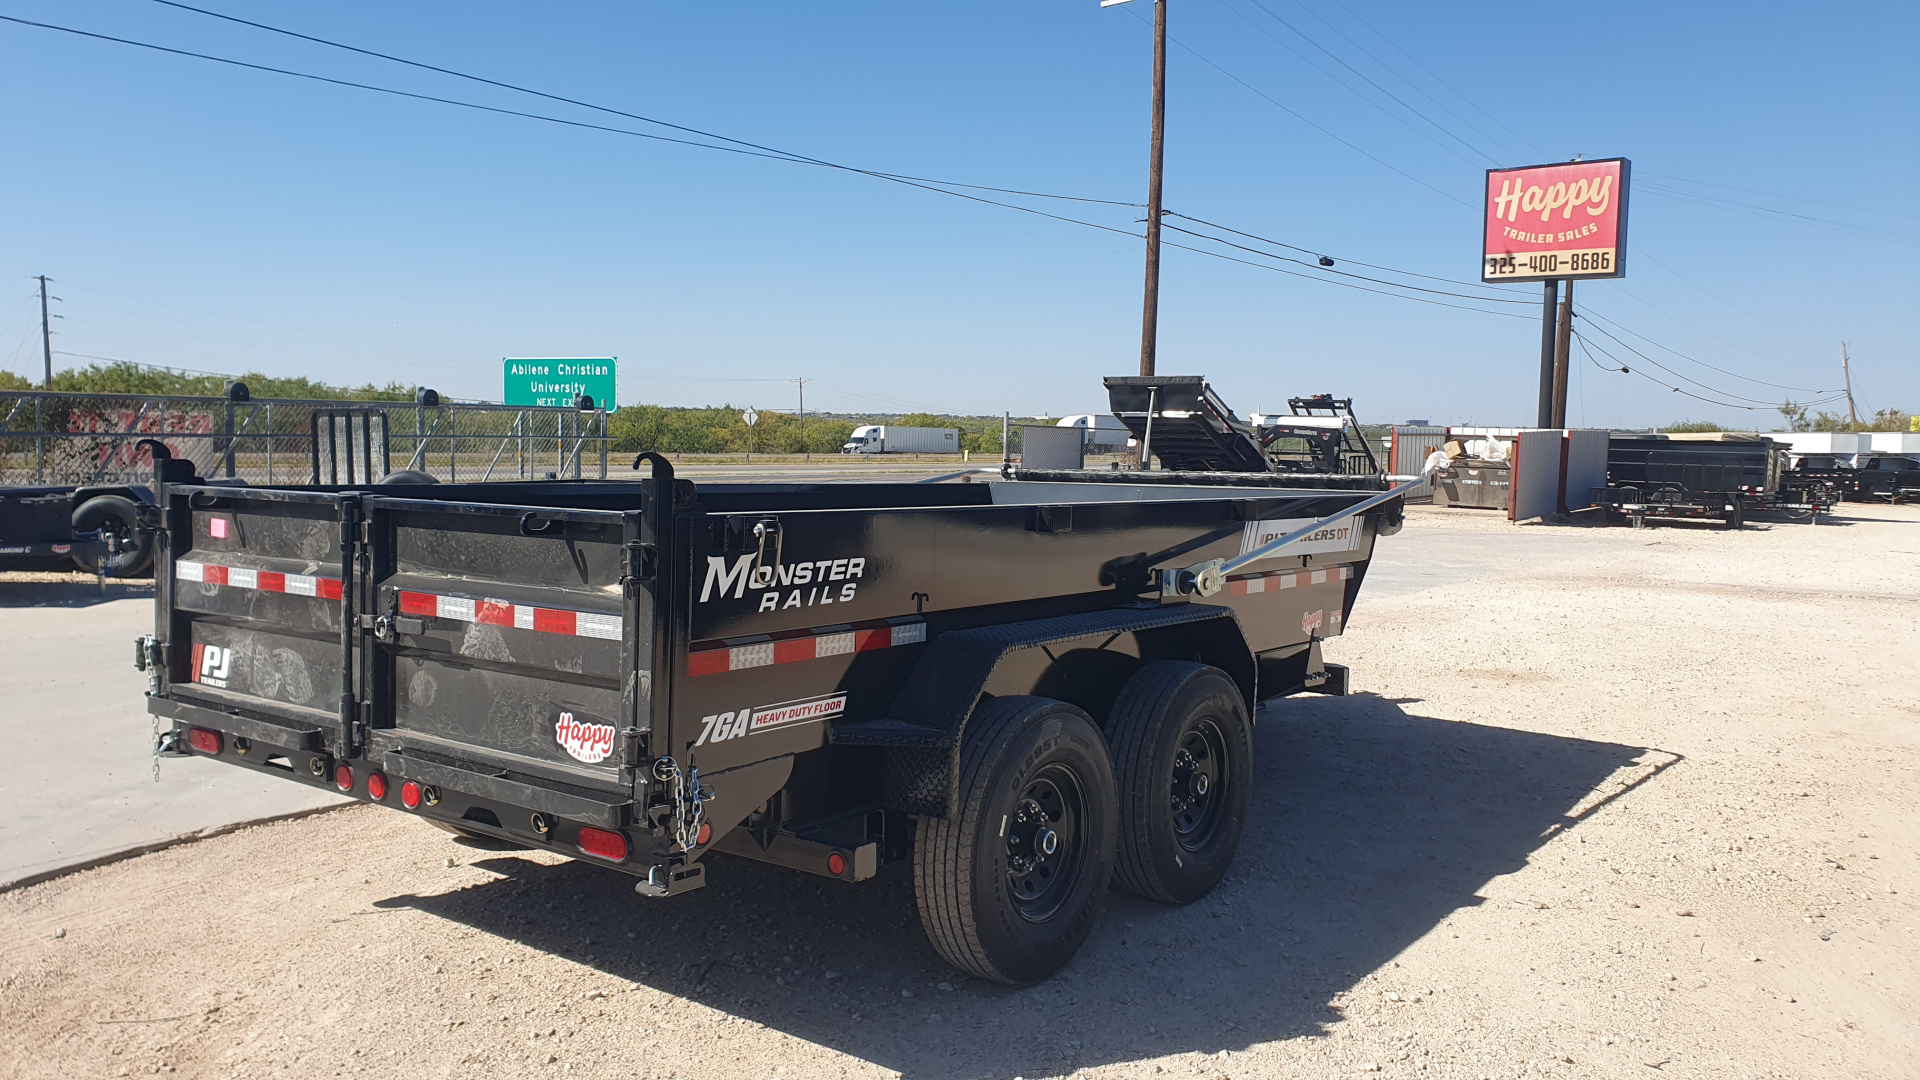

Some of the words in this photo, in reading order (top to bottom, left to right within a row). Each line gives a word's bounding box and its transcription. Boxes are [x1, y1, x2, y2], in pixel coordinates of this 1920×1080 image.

[1494, 175, 1613, 222] Happy
[1503, 226, 1554, 243] TRAILER
[1557, 222, 1598, 242] SALES
[1489, 252, 1610, 274] 325-400-8686
[511, 364, 549, 375] Abilene
[557, 363, 608, 375] Christian
[530, 381, 586, 396] University
[536, 398, 556, 407] NEXT
[1336, 528, 1349, 540] DT
[699, 551, 866, 603] MONSTER
[758, 583, 857, 613] RAILS
[201, 645, 231, 679] PJ
[200, 676, 227, 689] TRAILERS
[557, 715, 614, 754] Happy
[694, 708, 751, 747] 7GA
[755, 710, 788, 726] HEAVY
[788, 705, 814, 719] DUTY
[813, 700, 842, 714] FLOOR
